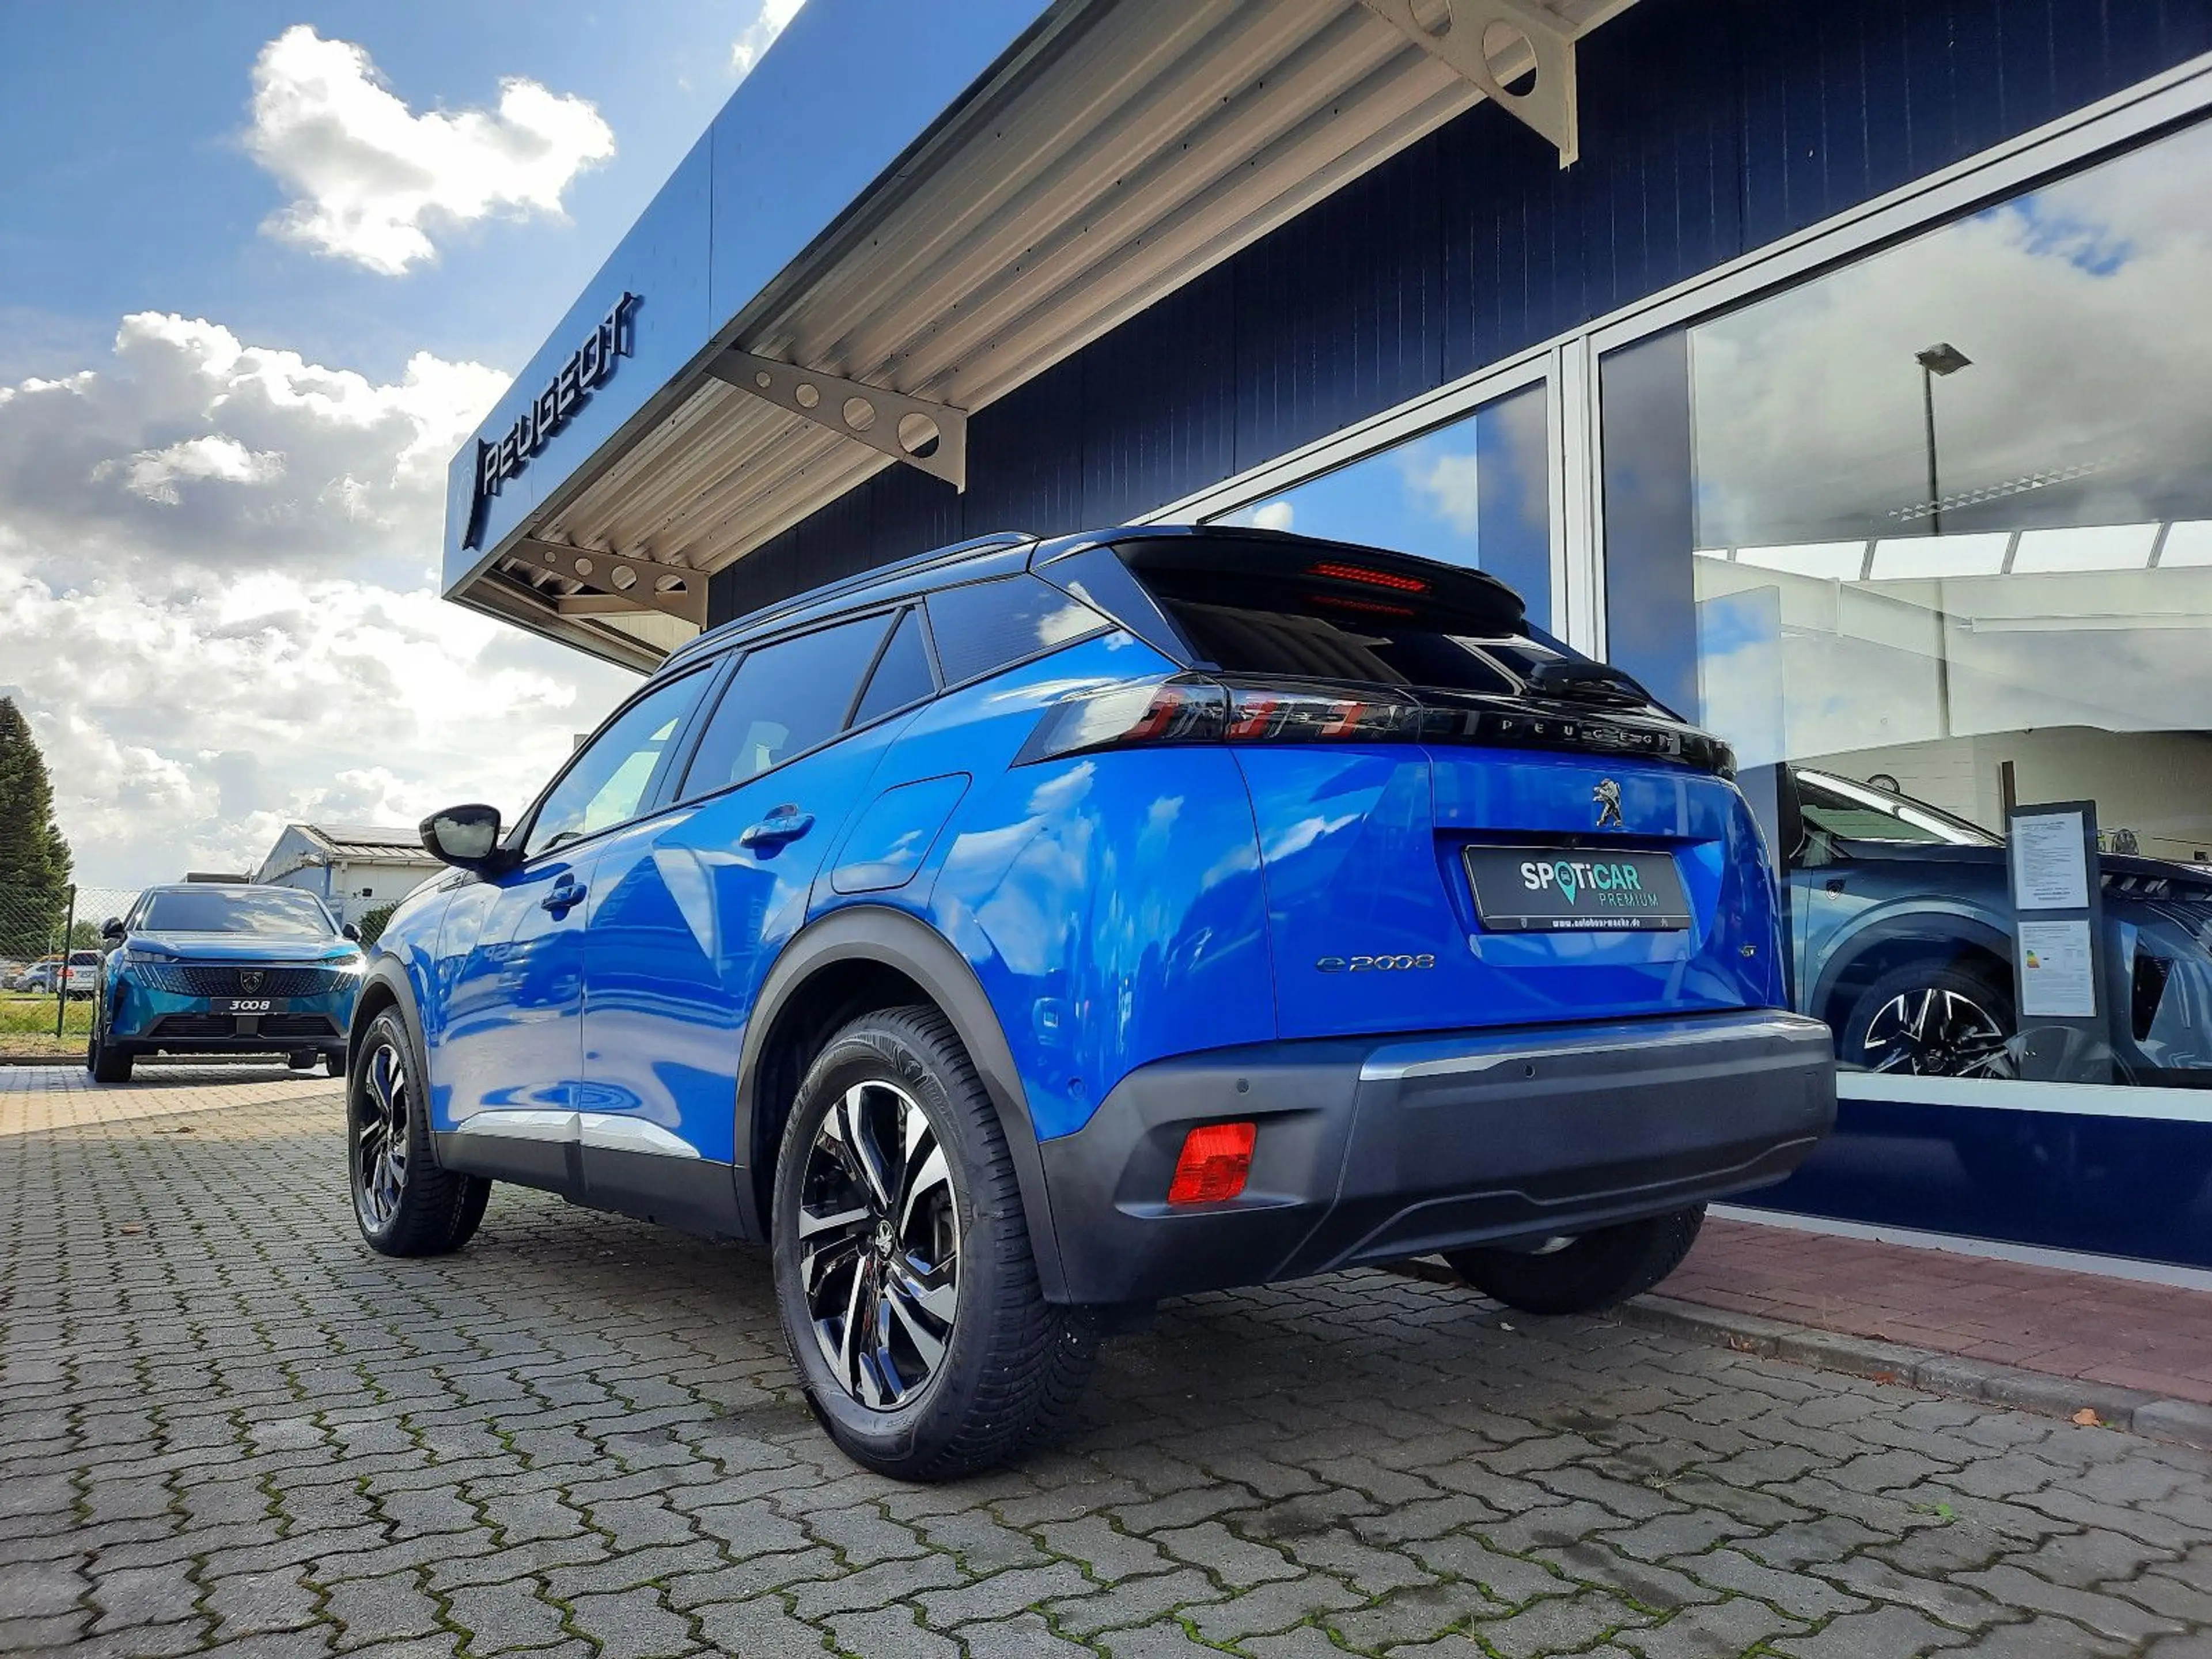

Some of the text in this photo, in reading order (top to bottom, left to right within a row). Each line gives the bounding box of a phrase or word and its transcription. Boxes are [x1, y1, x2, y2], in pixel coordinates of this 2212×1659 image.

[483, 291, 638, 495] PEUGEOT
[1502, 719, 1674, 747] PEUGEOT
[1599, 893, 1659, 907] PREMIUM
[229, 1000, 271, 1010] 3008
